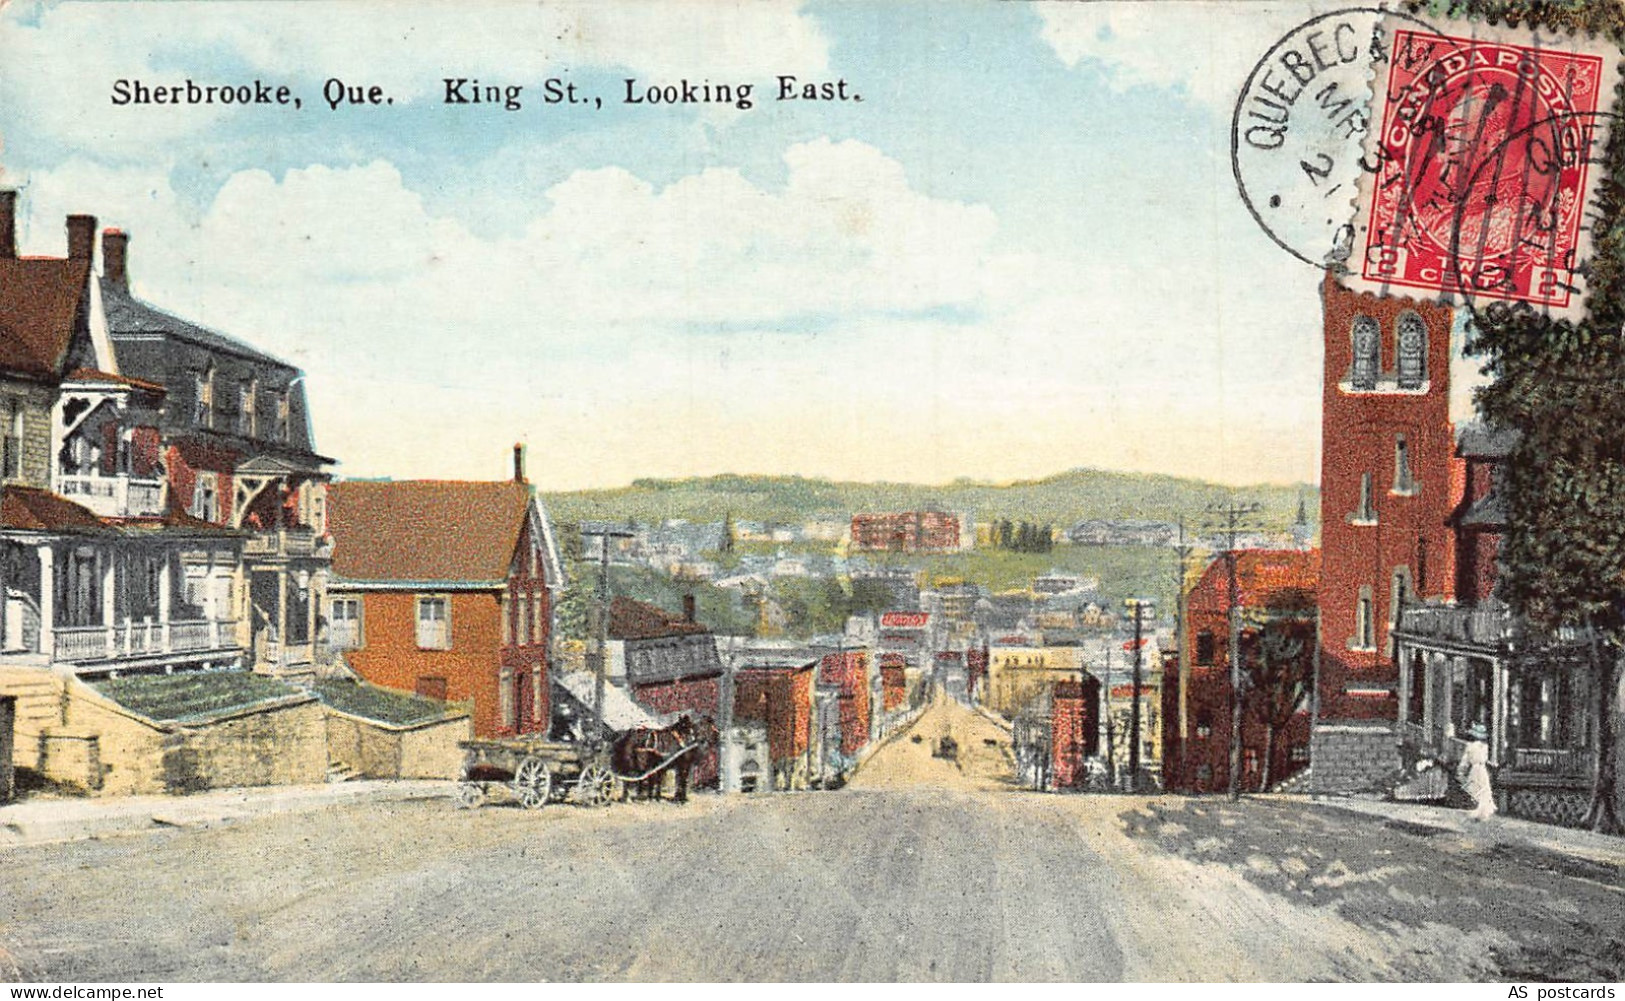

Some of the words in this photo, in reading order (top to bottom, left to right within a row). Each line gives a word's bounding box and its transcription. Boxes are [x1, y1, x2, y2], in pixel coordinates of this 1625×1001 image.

[1244, 22, 1358, 150] QUEBEC
[1496, 49, 1580, 172] POSTAGE
[1435, 254, 1501, 277] TWO
